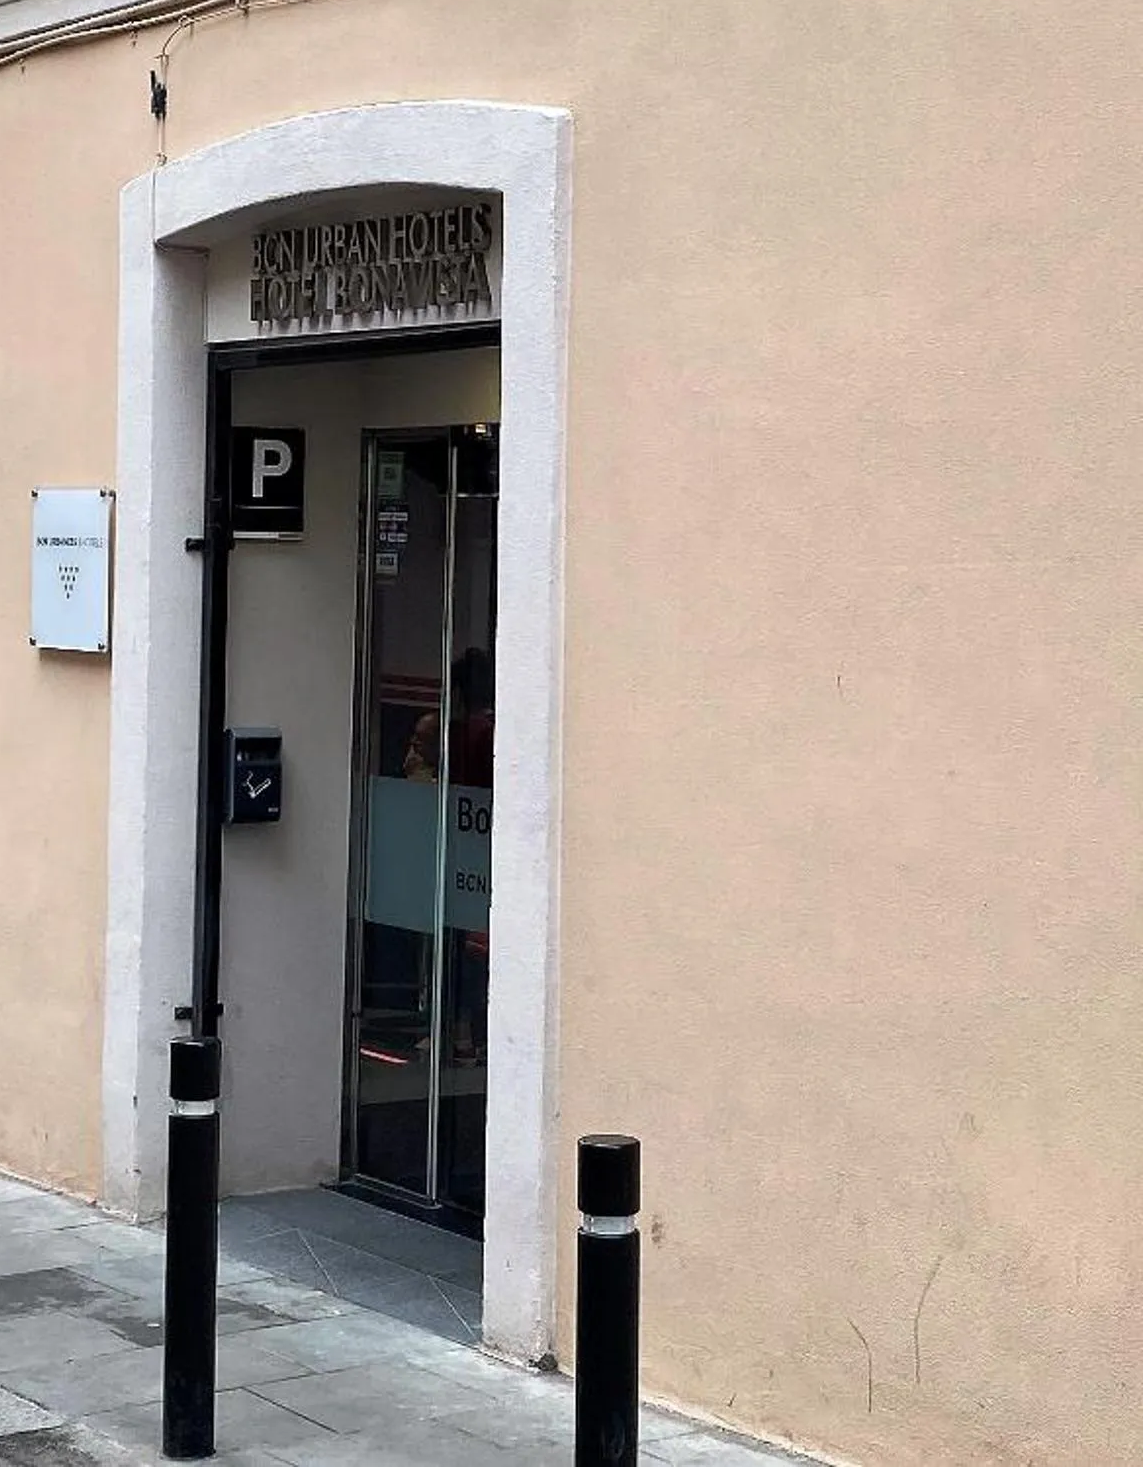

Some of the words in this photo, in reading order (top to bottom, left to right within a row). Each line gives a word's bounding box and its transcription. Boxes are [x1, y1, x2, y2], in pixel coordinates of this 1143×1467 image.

[251, 230, 296, 273] BCN
[304, 217, 386, 268] URBAN
[390, 203, 493, 261] HOTELS
[250, 269, 334, 321] HOTEL
[335, 252, 492, 314] BONAVISTA
[252, 439, 293, 498] P
[456, 871, 487, 894] BCN
